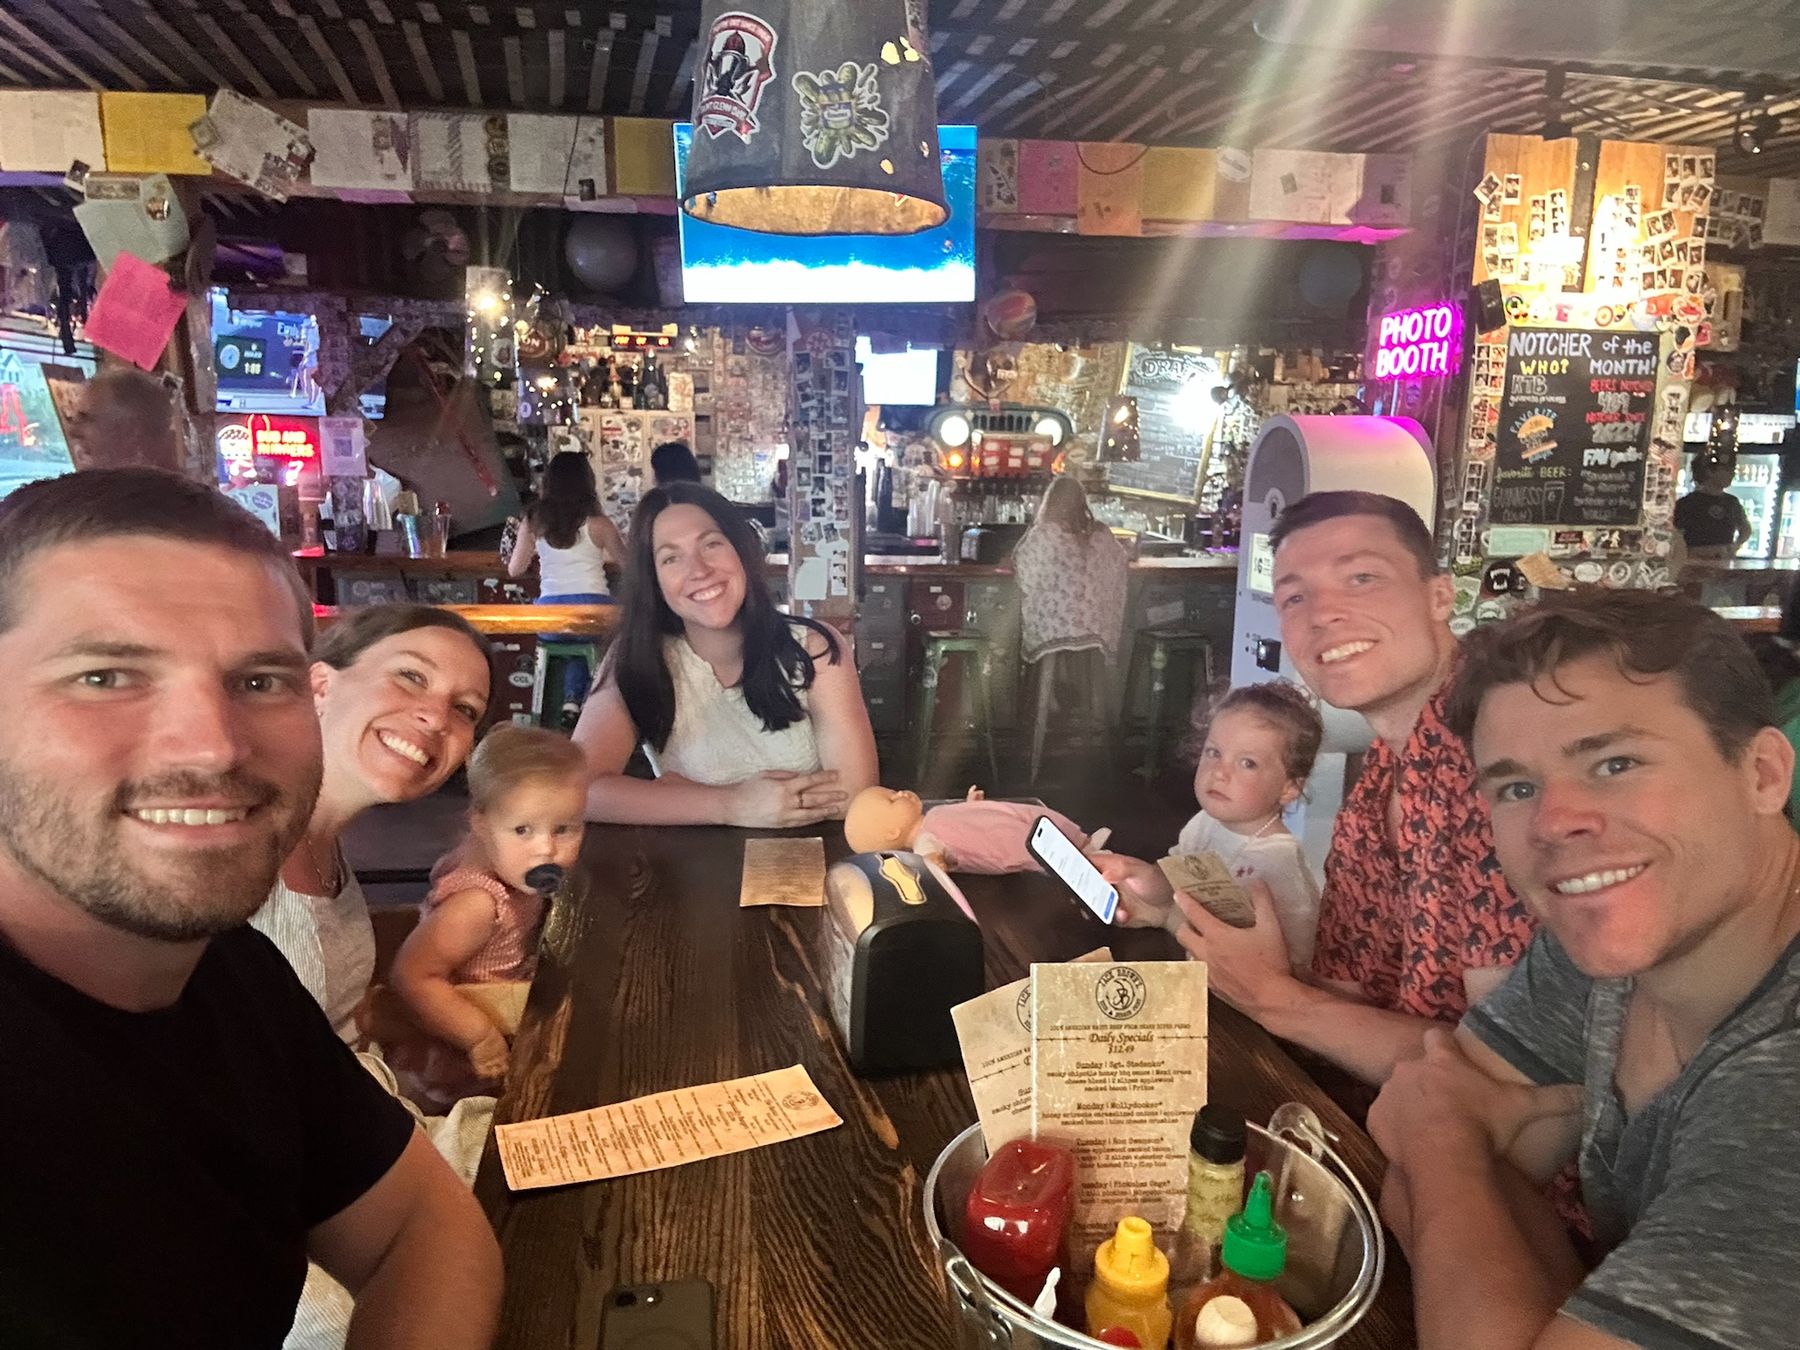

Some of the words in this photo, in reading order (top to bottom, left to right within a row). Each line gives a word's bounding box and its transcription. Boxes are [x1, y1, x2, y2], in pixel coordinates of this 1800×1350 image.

[1379, 307, 1452, 346] PHOTO
[1508, 333, 1592, 358] NOTCHER
[1602, 336, 1620, 354] of
[1622, 338, 1652, 355] the
[1376, 340, 1448, 377] BOOTH
[1520, 359, 1570, 375] WHO?
[1590, 356, 1657, 375] MONTH!
[1511, 374, 1547, 395] KTB
[1510, 408, 1558, 434] FAVORITE
[1089, 1032, 1115, 1044] Daily
[1117, 1031, 1154, 1044] Specials
[1108, 1045, 1135, 1054] $12.49
[1076, 1061, 1103, 1069] Sunday
[1109, 1061, 1124, 1069] Sgt.
[1077, 1102, 1104, 1111] Monday
